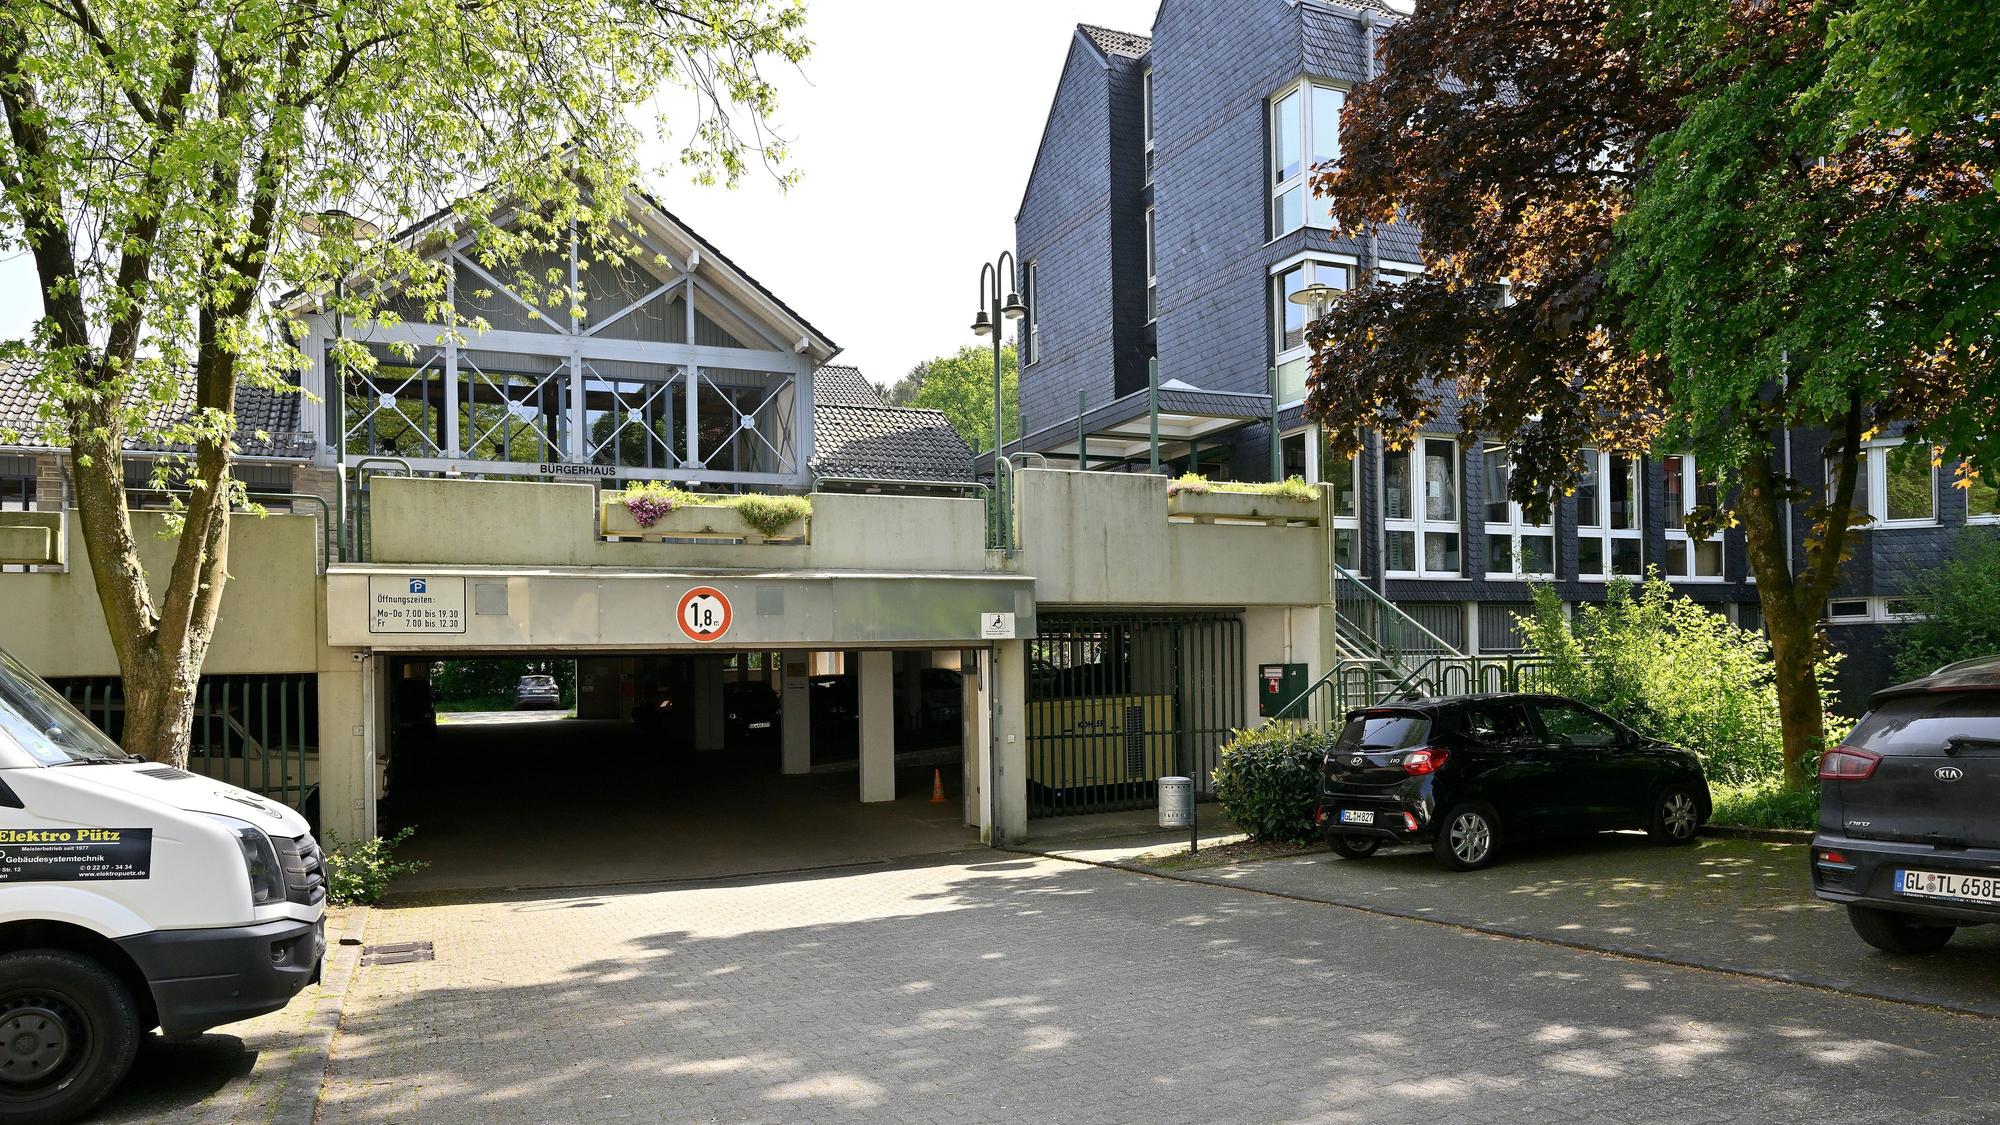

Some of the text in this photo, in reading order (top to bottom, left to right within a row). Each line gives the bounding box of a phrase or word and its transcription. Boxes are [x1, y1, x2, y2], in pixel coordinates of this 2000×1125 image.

[540, 462, 616, 475] BÜRGERHAUS
[414, 582, 422, 593] P
[377, 609, 459, 618] Mo-Do 7.00 bis 19.30
[691, 602, 712, 628] 1,8
[377, 619, 459, 628] Fr 7.00 bis 12.30
[1938, 769, 1958, 779] KIA
[1344, 811, 1374, 822] GL H 827
[0, 829, 120, 842] Elektro Pütz
[5, 854, 105, 864] Gebäudesystemtechnik
[1905, 872, 1925, 891] GL
[1937, 875, 1956, 894] TL
